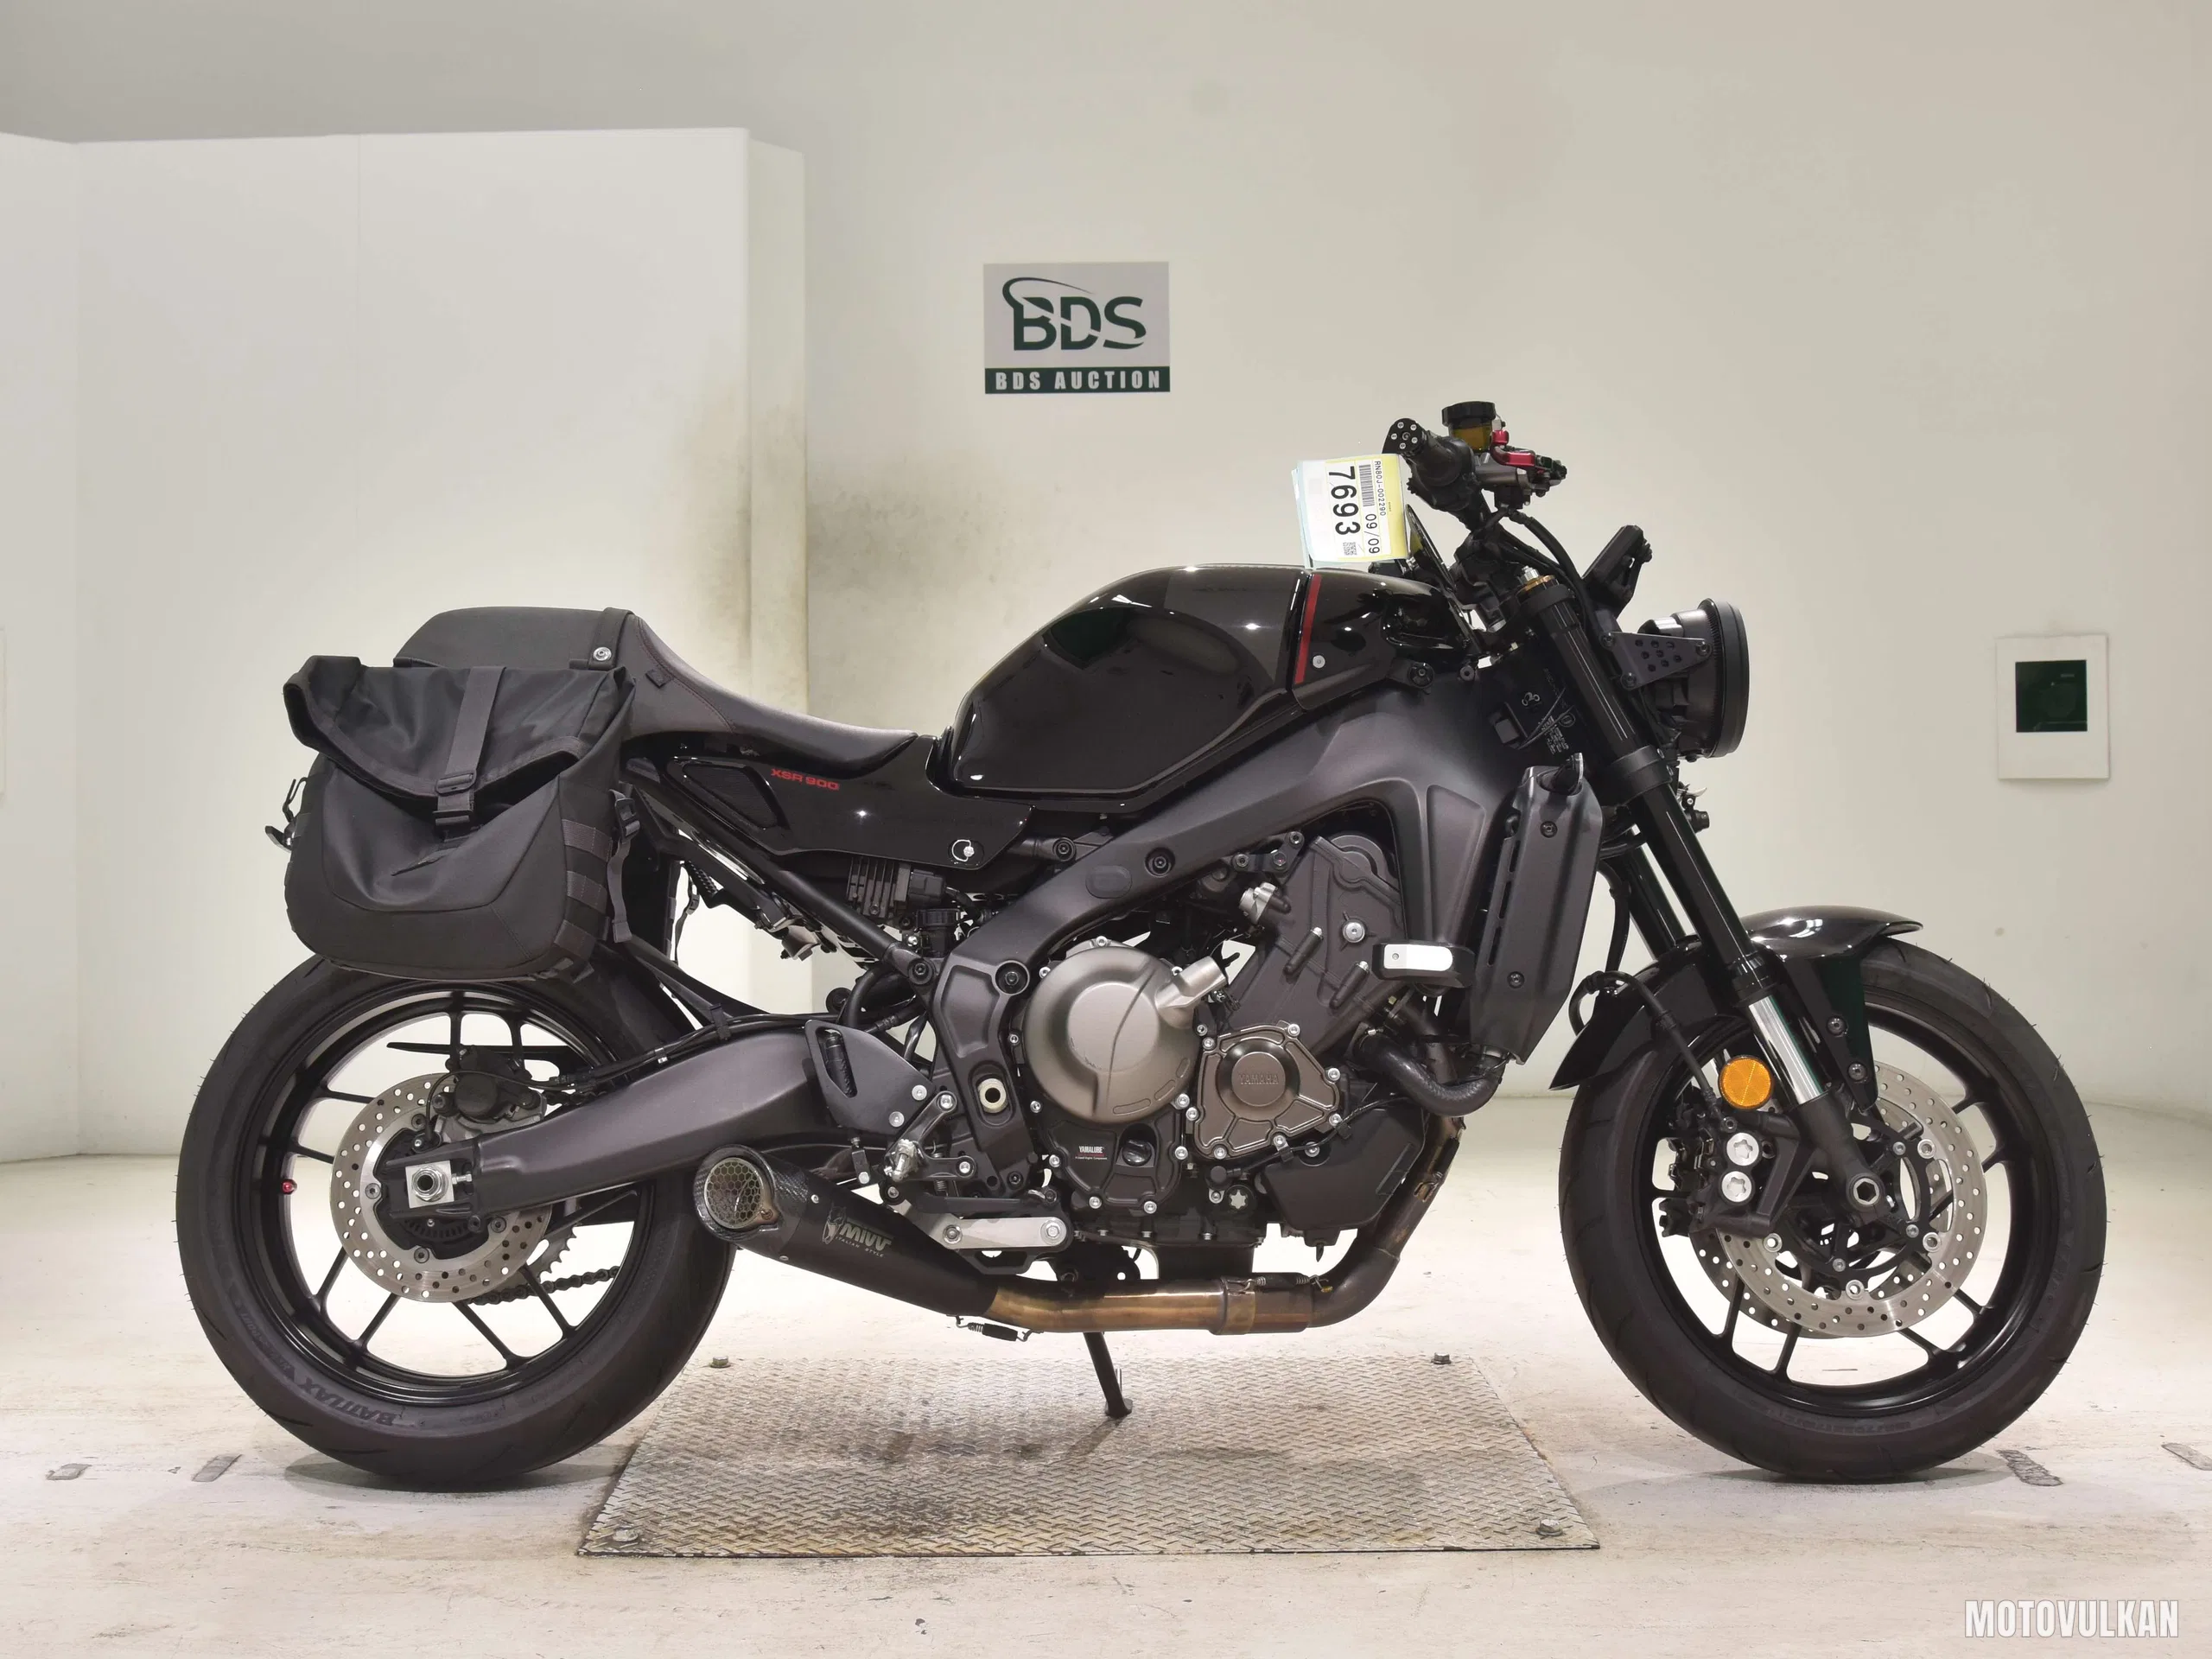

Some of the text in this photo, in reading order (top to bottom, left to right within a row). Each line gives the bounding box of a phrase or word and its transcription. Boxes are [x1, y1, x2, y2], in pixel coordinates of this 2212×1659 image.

[1002, 276, 1147, 351] BDS
[995, 370, 1160, 390] BDS AUCTION
[1328, 466, 1361, 535] 7693
[1374, 461, 1387, 517] RN80J-002290
[1364, 513, 1381, 554] 09/09
[771, 768, 840, 791] XSR 900
[1239, 1073, 1280, 1085] YAMAHA
[835, 1236, 884, 1257] ITALIAN STYLE
